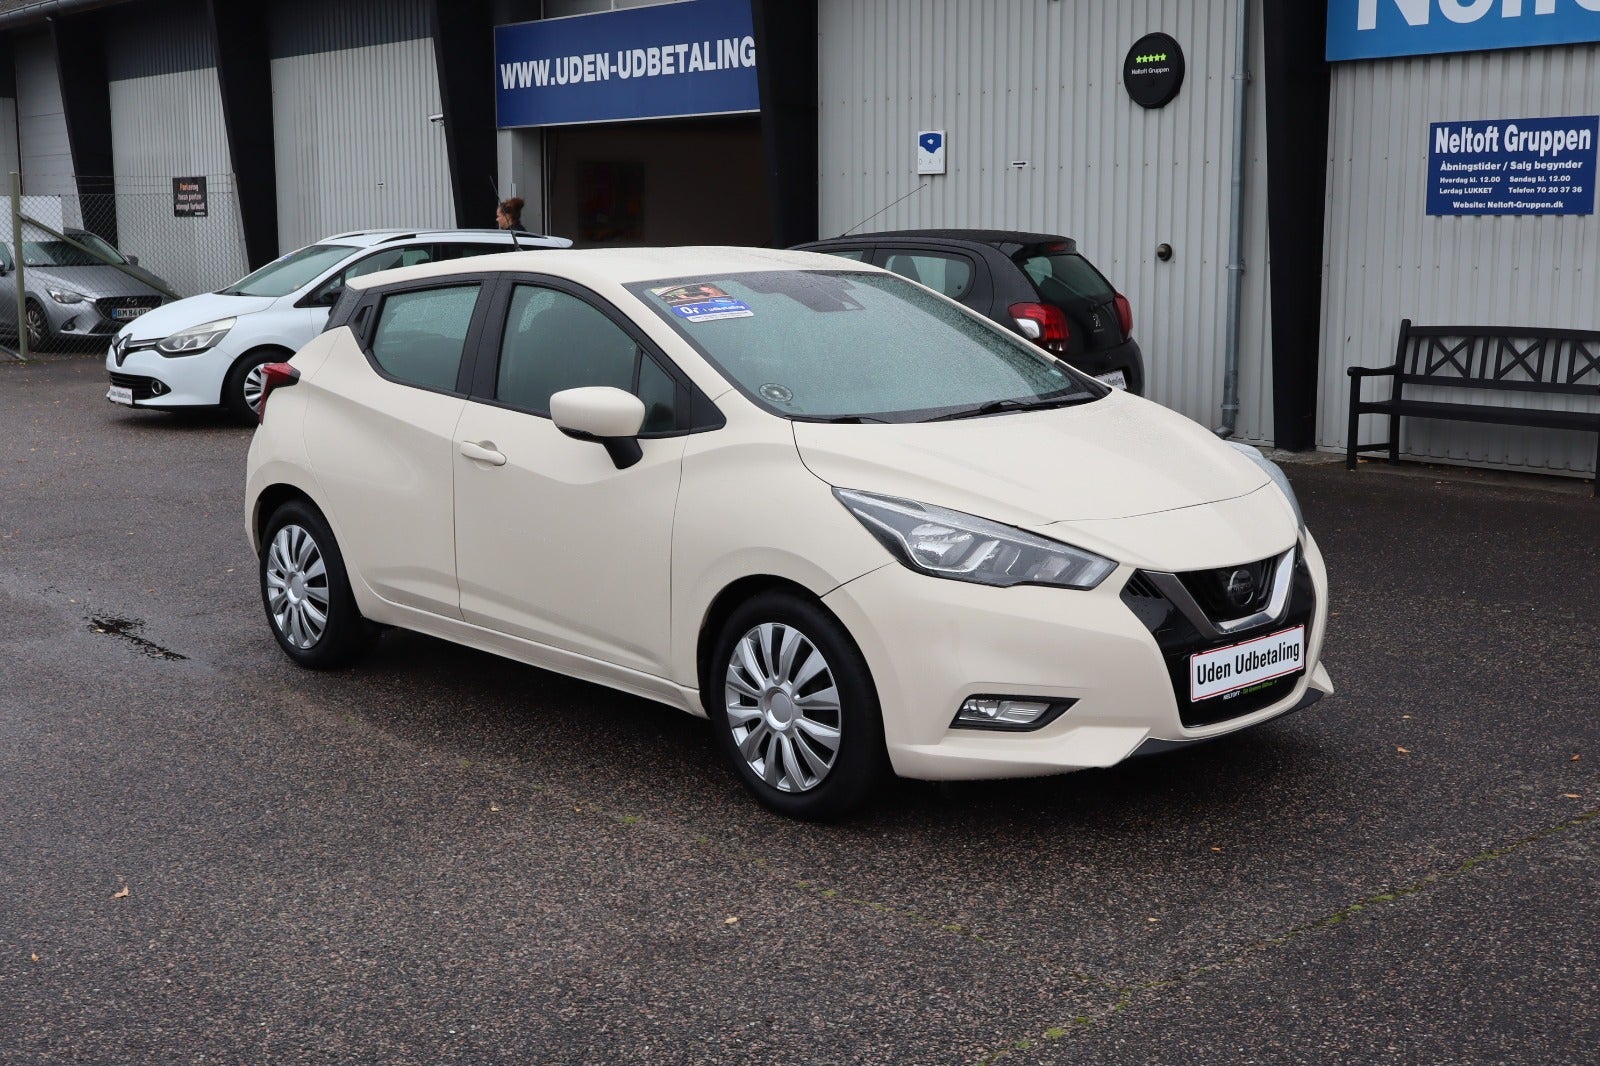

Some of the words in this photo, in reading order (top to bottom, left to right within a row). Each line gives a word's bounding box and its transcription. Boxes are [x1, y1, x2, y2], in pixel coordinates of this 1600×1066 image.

[500, 35, 755, 90] WWW.UDEN-UDBETALING
[1148, 67, 1170, 75] Gruppen
[1435, 125, 1499, 154] Neltoft
[1504, 124, 1591, 157] Gruppen
[1440, 160, 1501, 172] Åbningstider
[1510, 161, 1532, 171] Salg
[1534, 160, 1583, 171] begynder
[1439, 176, 1469, 184] Hverdag
[1509, 176, 1536, 184] Søndag
[1439, 187, 1463, 195] Lørdag
[1452, 201, 1486, 209] Website:
[1487, 200, 1564, 210] Neltoft-Gruppen.dk
[1196, 661, 1231, 685] Uden
[1235, 641, 1300, 675] Udbetaling
